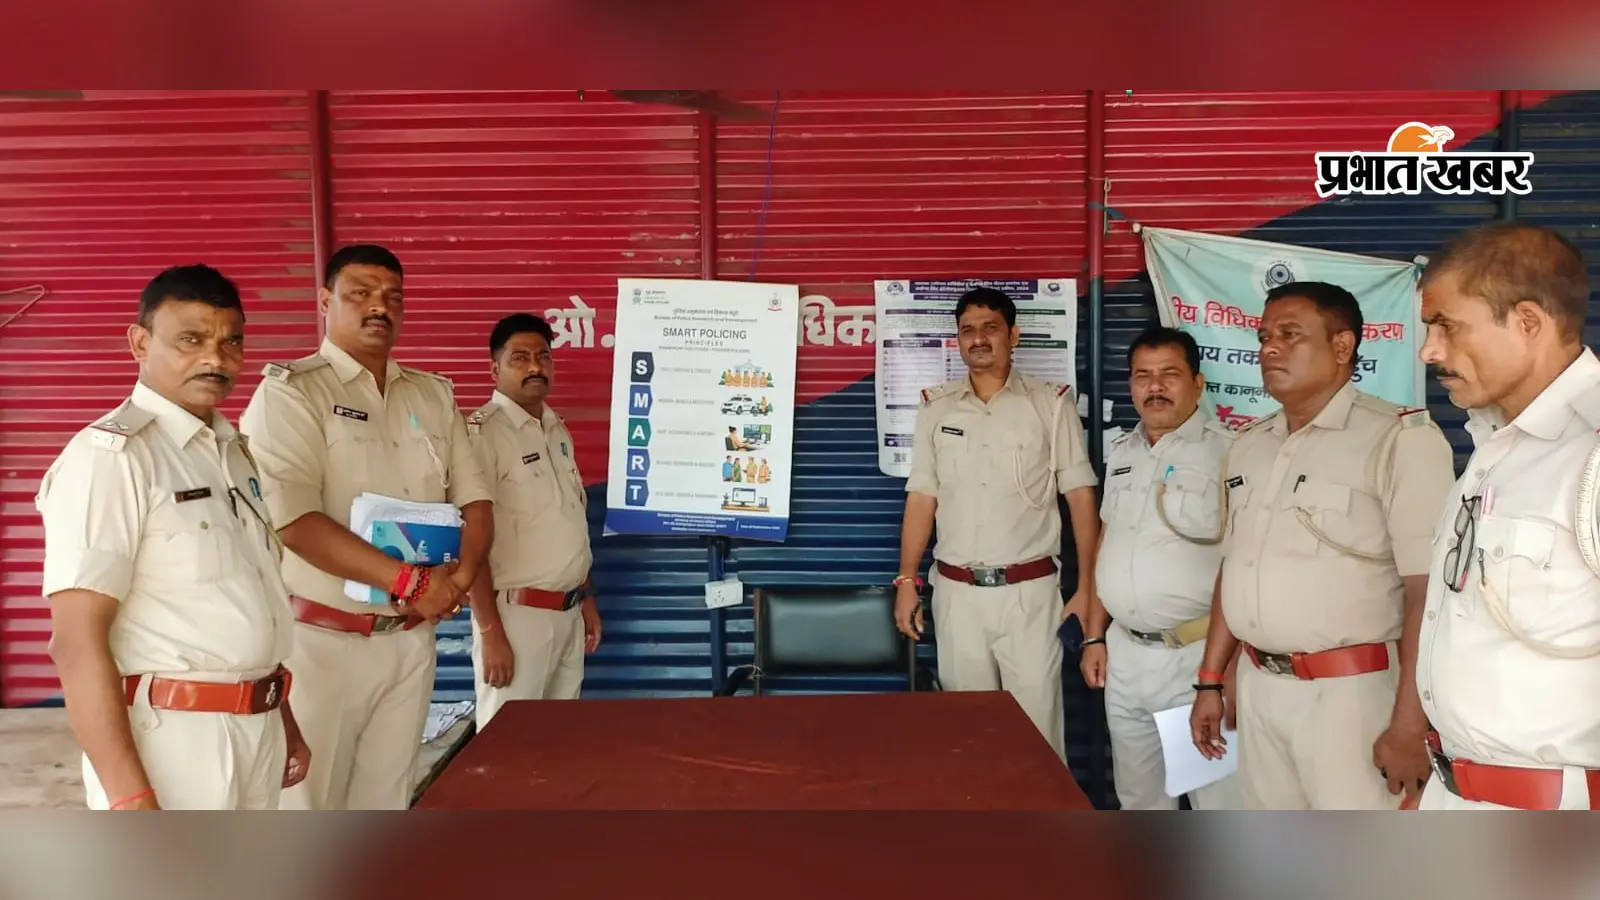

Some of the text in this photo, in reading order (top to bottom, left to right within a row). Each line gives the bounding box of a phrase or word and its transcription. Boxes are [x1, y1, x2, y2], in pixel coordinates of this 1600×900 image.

[798, 294, 876, 347] धिक
[1171, 296, 1198, 323] ीय
[1362, 323, 1404, 340] करण
[662, 327, 747, 340] SMART POLICING
[1198, 345, 1221, 362] ाय
[635, 359, 648, 375] S
[634, 392, 648, 408] M
[632, 425, 646, 440] A
[631, 455, 645, 471] R
[630, 485, 642, 500] T
